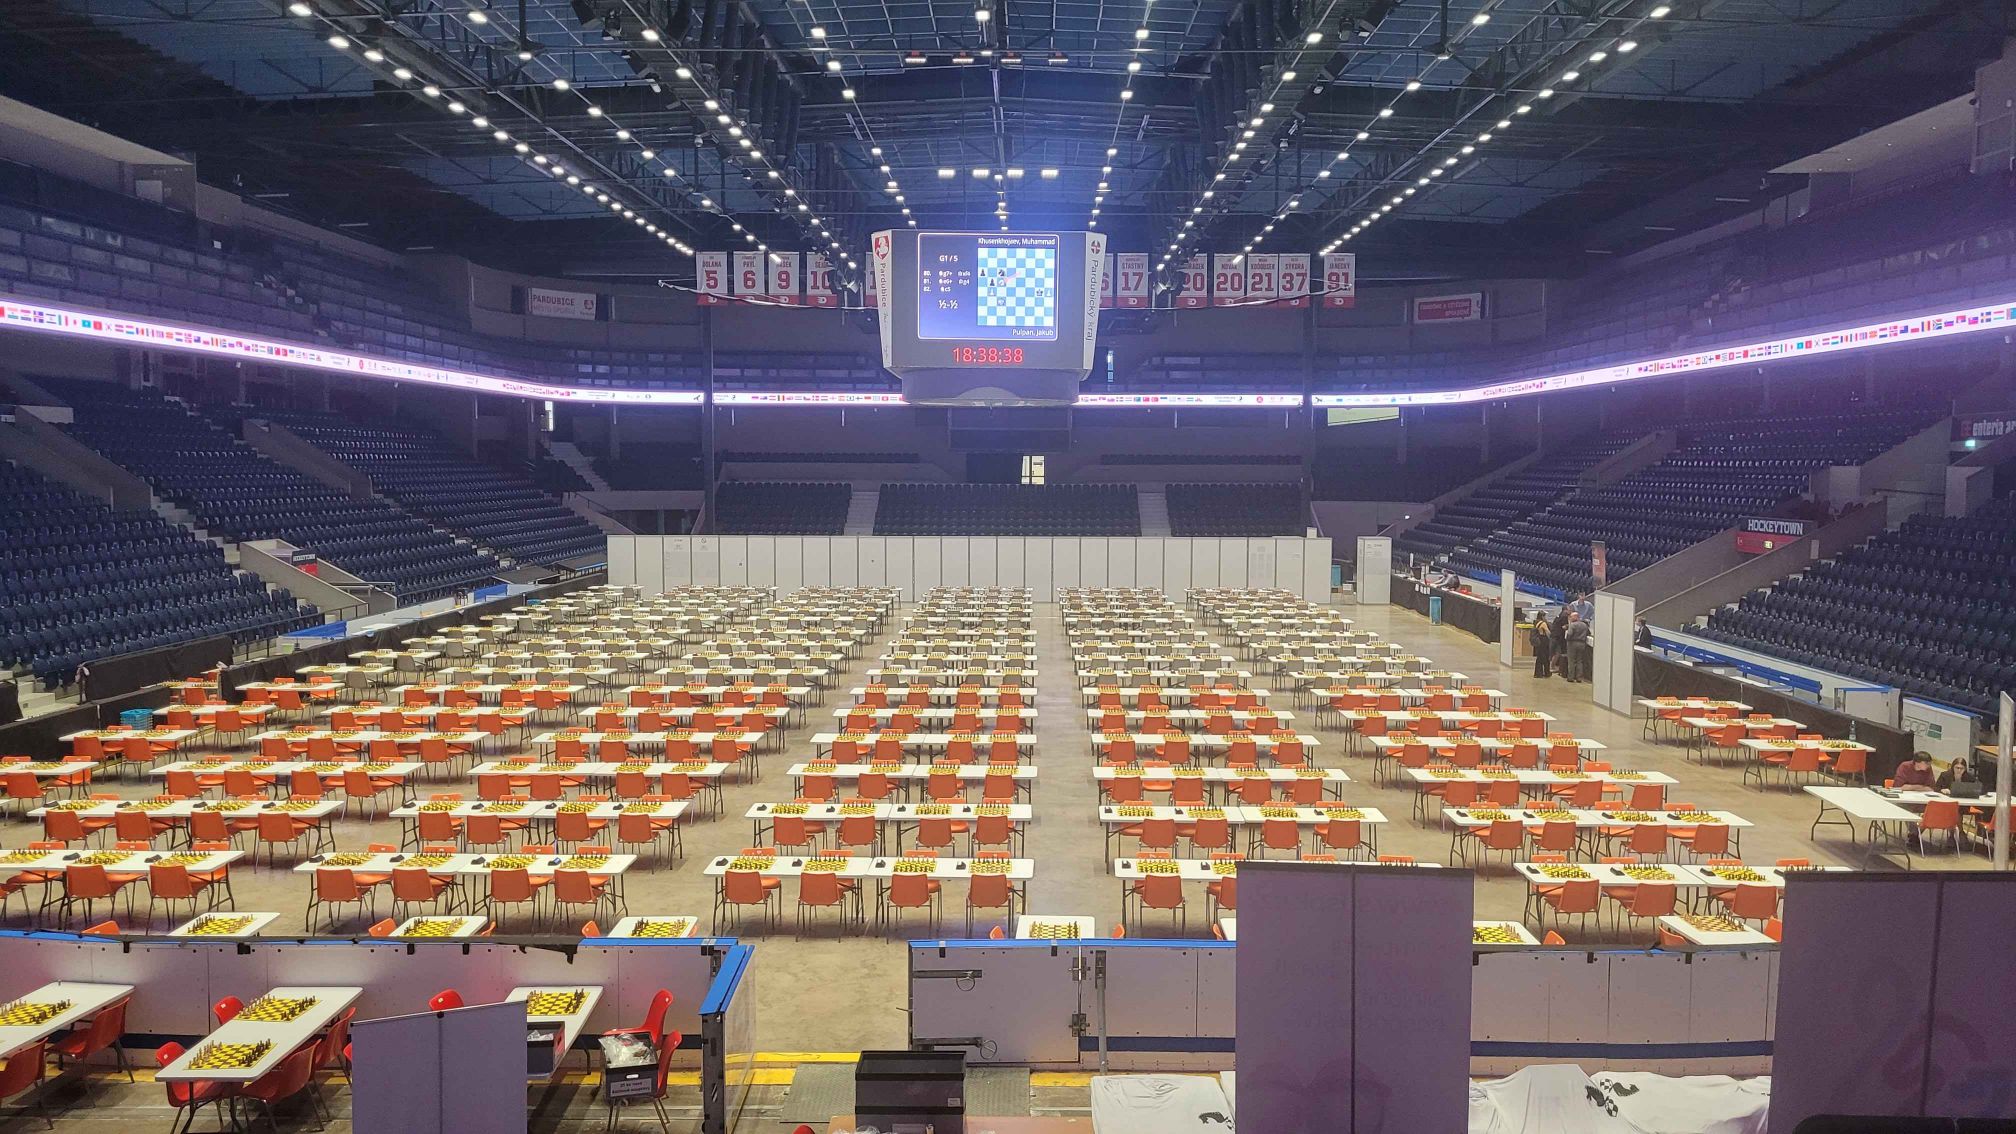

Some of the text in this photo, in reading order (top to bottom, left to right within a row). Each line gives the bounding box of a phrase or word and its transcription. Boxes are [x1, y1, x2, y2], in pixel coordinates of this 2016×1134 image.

[705, 270, 719, 290] 5
[743, 270, 756, 290] 6
[777, 270, 790, 290] 9
[880, 262, 888, 308] Pardubice
[1121, 272, 1144, 291] 17
[1216, 272, 1243, 292] 20
[1250, 272, 1274, 292] 21
[1281, 272, 1308, 292] 37
[1327, 271, 1350, 290] 91
[533, 294, 575, 306] PARDUBICE
[1036, 328, 1054, 337] Jakub
[1085, 321, 1096, 341] kraj
[952, 347, 1024, 364] 18:38:38
[1747, 519, 1803, 535] HOCKEYTOWN
